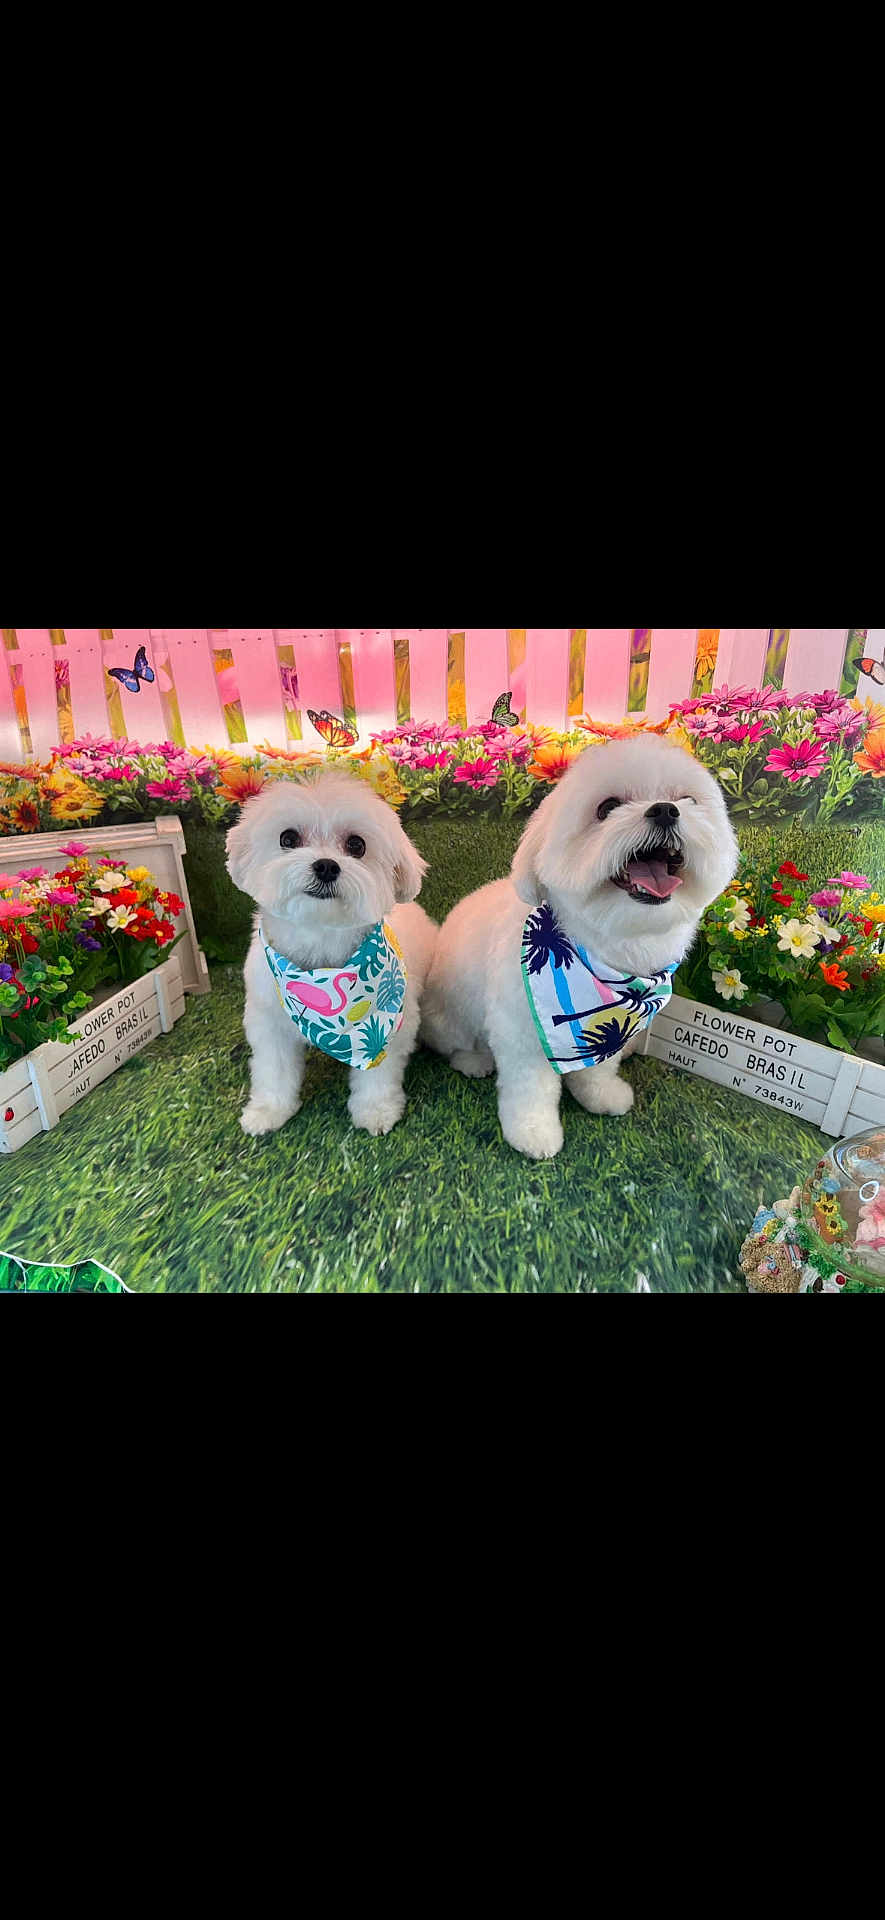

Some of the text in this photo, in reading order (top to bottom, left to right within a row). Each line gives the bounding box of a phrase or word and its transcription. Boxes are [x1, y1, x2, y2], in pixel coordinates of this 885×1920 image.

[117, 991, 135, 1014] POT
[674, 1027, 729, 1059] CAFEDO
[693, 1010, 797, 1057] FLOWER POT
[668, 1050, 697, 1068] HAUT
[754, 1085, 804, 1111] 73843W
